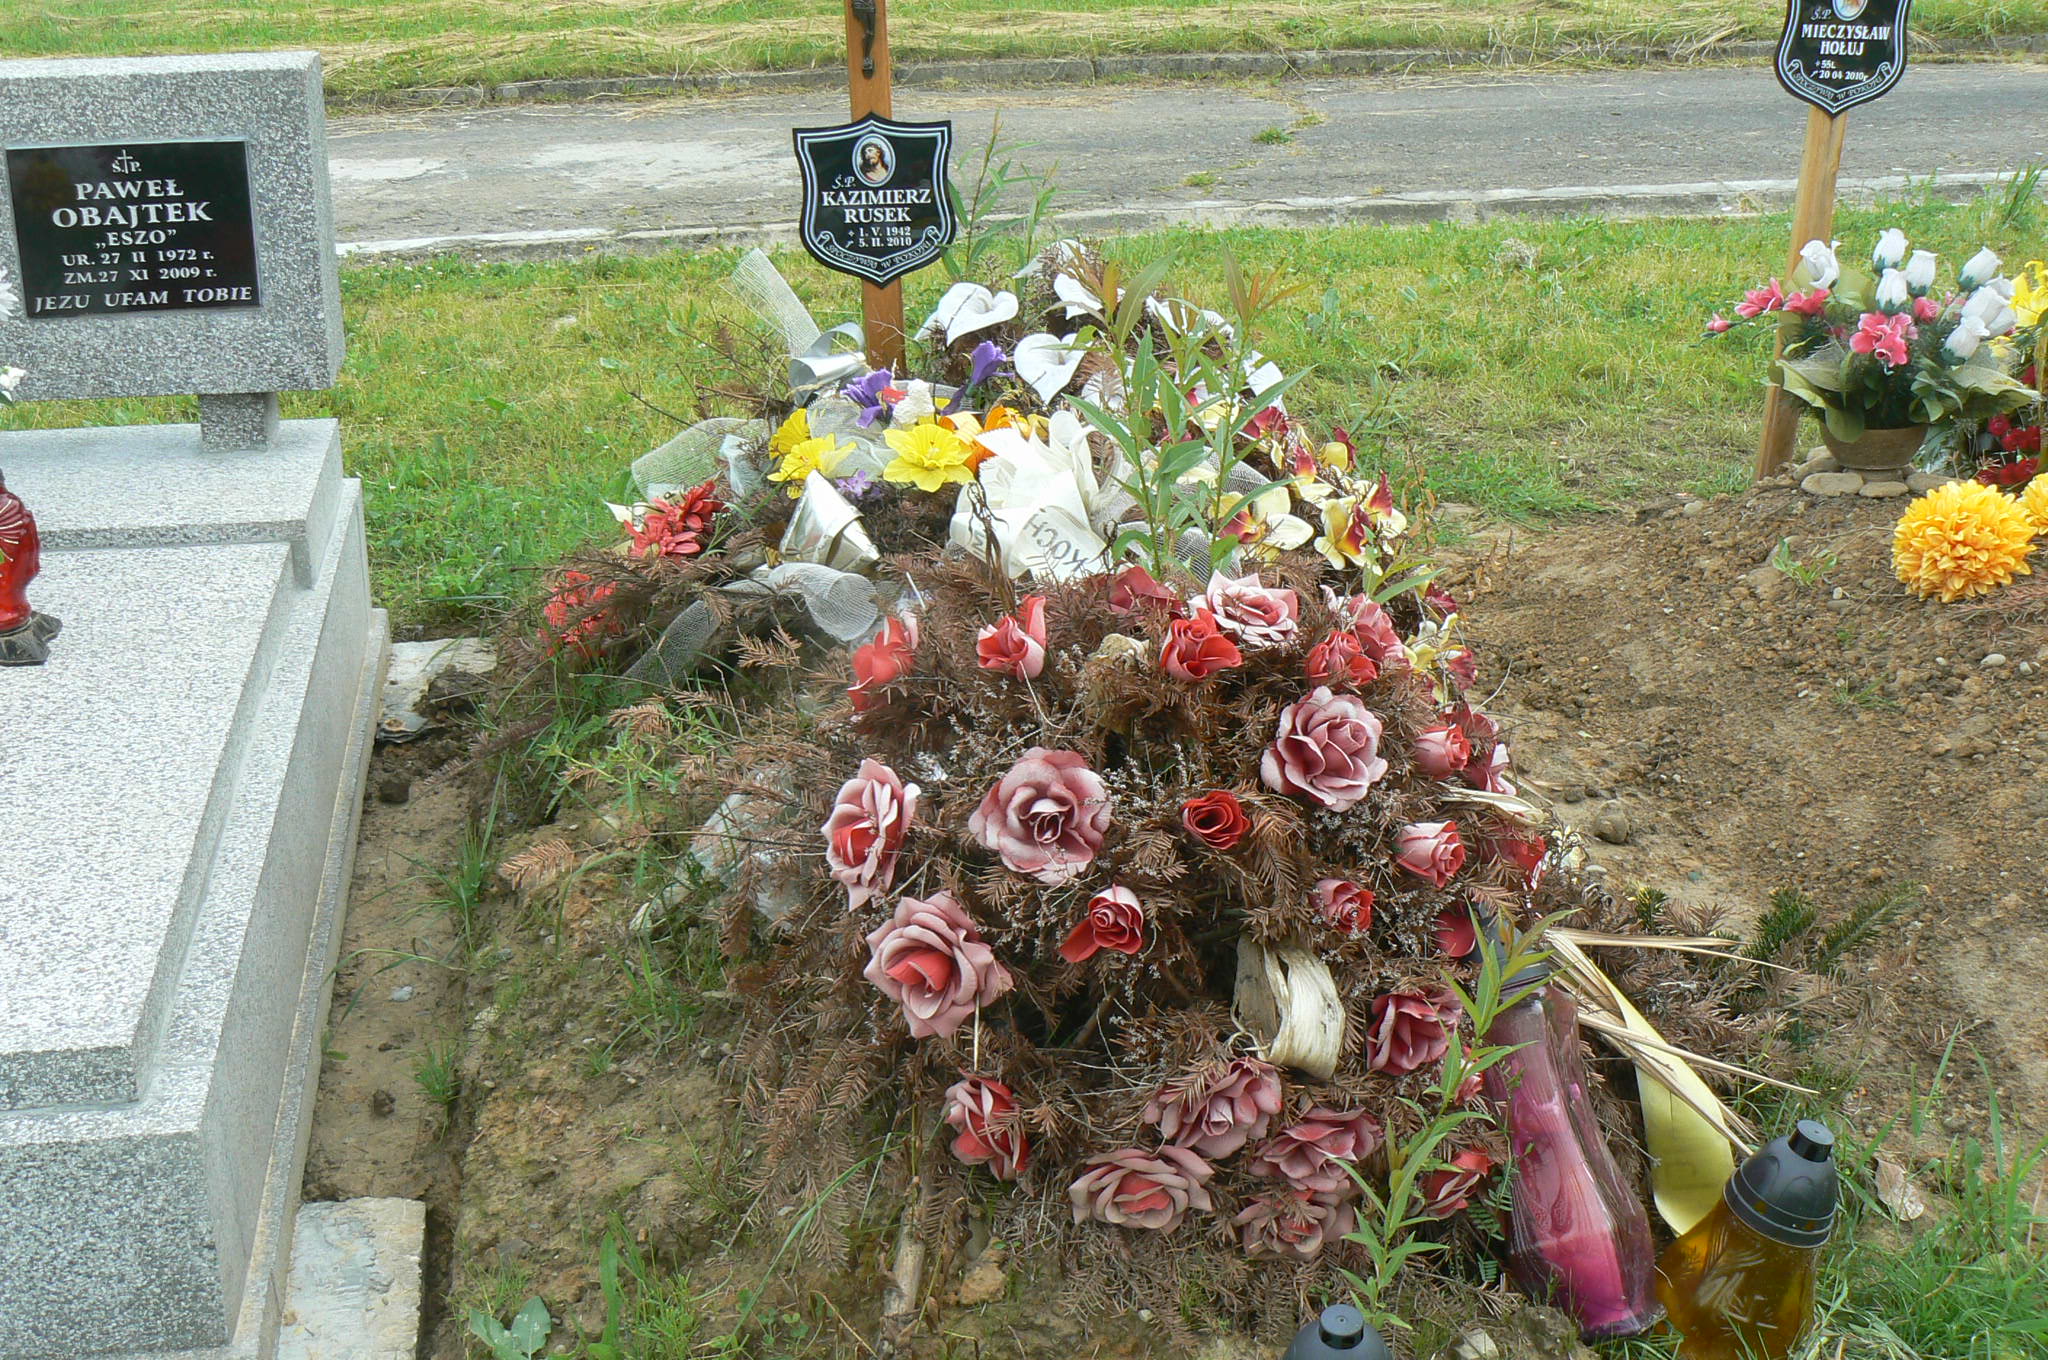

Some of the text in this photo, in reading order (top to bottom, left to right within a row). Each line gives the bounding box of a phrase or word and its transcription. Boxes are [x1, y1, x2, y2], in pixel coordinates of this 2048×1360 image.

[1801, 24, 1891, 40] MIECZYSŁAW
[1820, 41, 1865, 56] HOŁUJ
[75, 179, 184, 200] PAWEŁ
[821, 189, 931, 207] KAZIMIERZ
[52, 201, 213, 229] OBAJTEK
[844, 207, 912, 224] RUSEK
[886, 226, 911, 236] 1942
[887, 237, 912, 247] 2010
[100, 252, 120, 265] 27
[132, 252, 146, 263] II
[157, 249, 197, 262] 1972
[129, 269, 149, 281] XI
[159, 267, 201, 280] 2009
[35, 286, 252, 313] JEZU UFAM TOBIE
